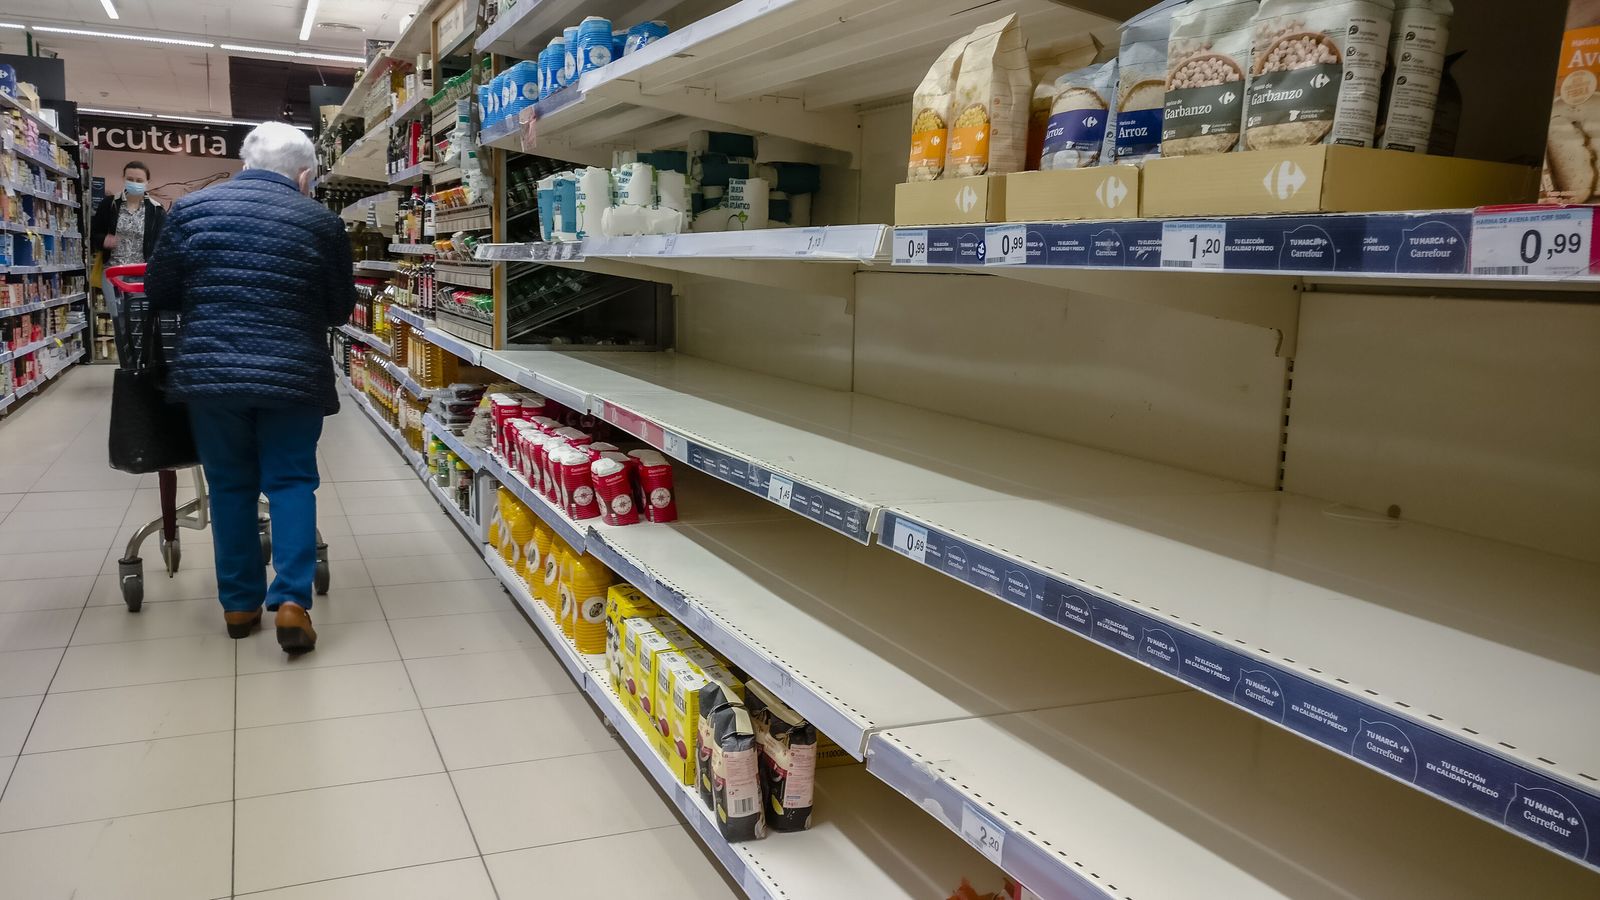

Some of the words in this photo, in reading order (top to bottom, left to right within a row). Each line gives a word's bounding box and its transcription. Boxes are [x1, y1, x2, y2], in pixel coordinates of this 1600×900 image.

[1252, 87, 1303, 106] Garbanzo
[1164, 104, 1212, 120] Garbanzo
[1118, 127, 1148, 139] Arroz
[907, 239, 925, 259] 0,99
[1001, 234, 1024, 256] 0,99
[1189, 234, 1221, 259] 1,20
[1420, 237, 1444, 245] MARCA
[1520, 229, 1581, 264] 0,99
[1290, 249, 1323, 258] Carrefour
[1410, 249, 1451, 258] Carrefour
[1064, 610, 1086, 624] Carrefour
[1146, 646, 1171, 662] Carrefour
[1154, 639, 1168, 650] MARCA
[1192, 661, 1210, 674] CALIDAD
[1214, 670, 1230, 682] PRECIO
[1200, 657, 1223, 672] ELECCIÓN
[1245, 678, 1252, 686] TU
[1252, 682, 1270, 694] MARCA
[1245, 688, 1274, 706] Carrefour
[1292, 704, 1298, 712] EN
[1300, 708, 1322, 722] CALIDAD
[1327, 720, 1348, 733] PRECIO
[1311, 704, 1338, 720] ELECCIÓN
[1366, 730, 1374, 738] TU
[1375, 734, 1398, 749] MARCA
[1366, 742, 1404, 763] Carrefour
[1426, 762, 1436, 772] EN
[1436, 767, 1466, 784] CALIDAD
[1472, 782, 1499, 798] PRECIO
[1441, 760, 1450, 770] TU
[1450, 766, 1486, 784] ELECCIÓN
[1523, 796, 1535, 808] TU
[1535, 802, 1564, 820] MARCA
[1523, 810, 1572, 838] Carrefour
